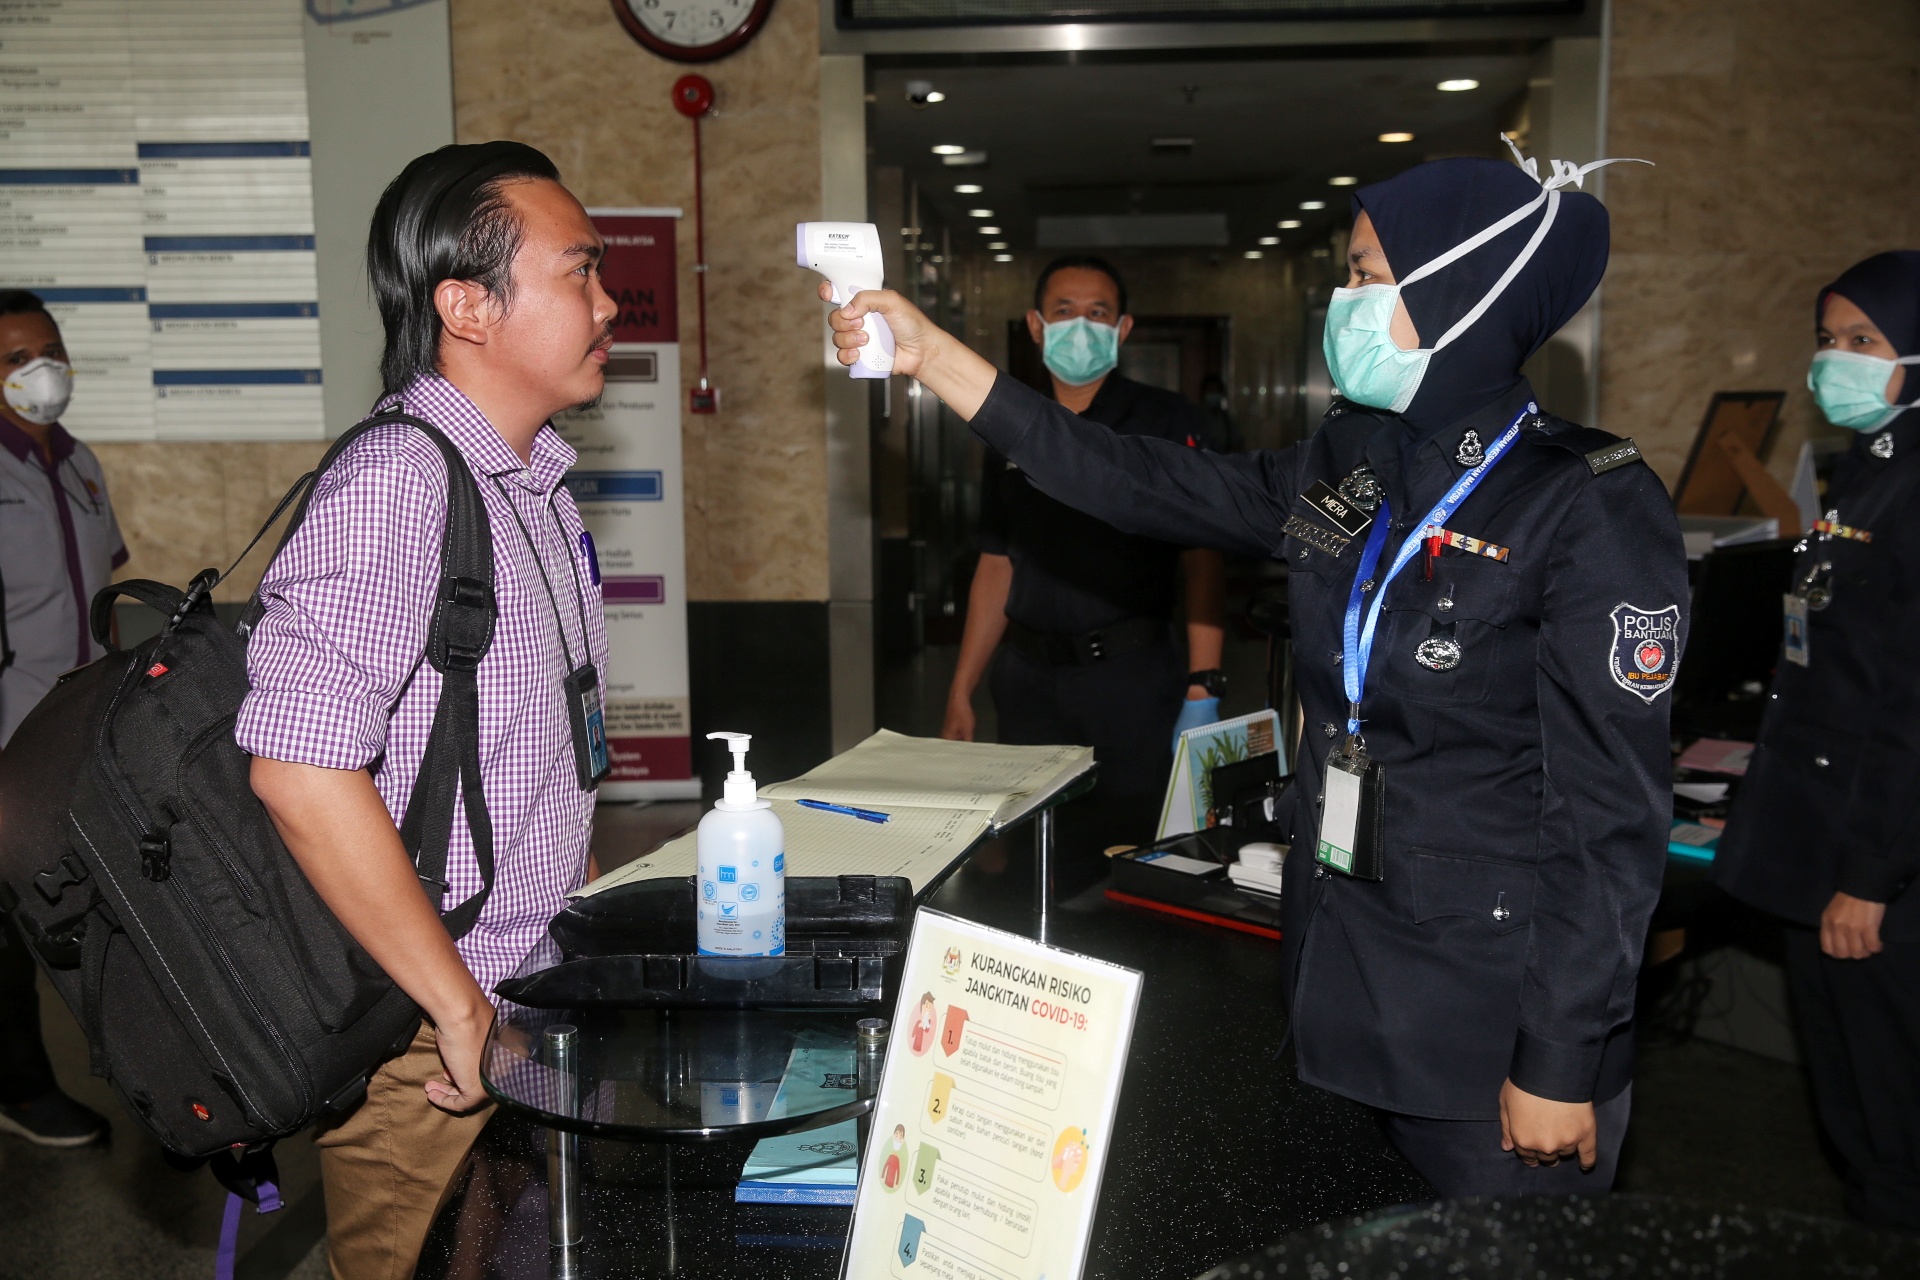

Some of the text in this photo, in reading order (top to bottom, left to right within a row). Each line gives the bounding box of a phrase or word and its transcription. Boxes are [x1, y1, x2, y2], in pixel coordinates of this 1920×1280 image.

[664, 11, 678, 30] 7
[709, 9, 724, 30] 5
[1320, 495, 1349, 519] MIERA
[1624, 616, 1672, 631] POLIS
[1624, 630, 1672, 640] BANTUAN
[1628, 672, 1640, 680] IBU
[1642, 672, 1668, 680] PEJABAT
[970, 952, 1092, 1004] KURANGKAN RISIKO
[965, 978, 1088, 1031] JANGKITAN COVID-19:
[948, 1030, 954, 1044] 1.
[932, 1098, 941, 1114] 2.
[918, 1168, 926, 1184] 3.
[904, 1242, 912, 1258] 4.
